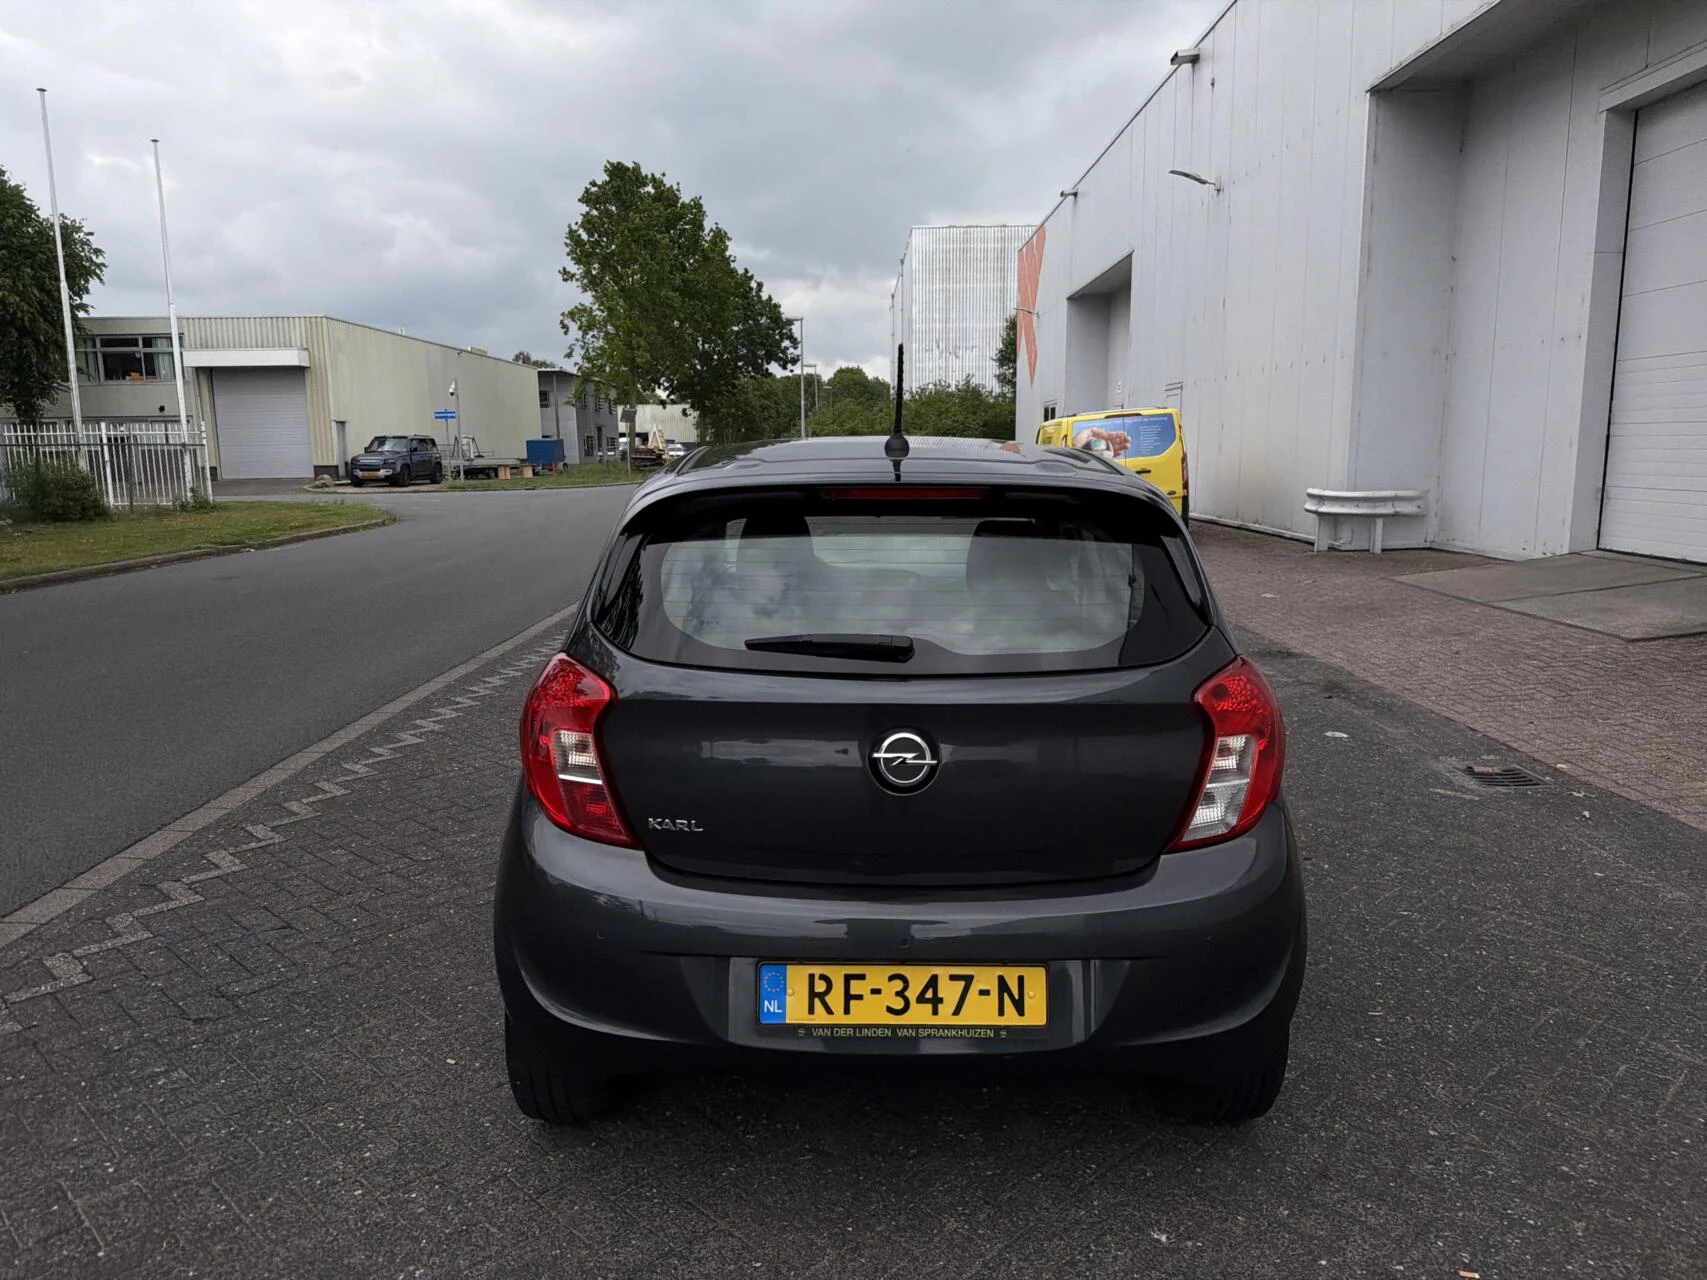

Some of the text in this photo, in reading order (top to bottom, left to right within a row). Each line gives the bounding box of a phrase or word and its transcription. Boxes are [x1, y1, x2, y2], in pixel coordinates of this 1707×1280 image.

[648, 817, 704, 832] KARL
[807, 973, 1025, 1017] RF-347-N
[763, 1000, 782, 1013] NL
[811, 1027, 995, 1038] VAN DER LINDEN VAN SPRANKHUIZEN
